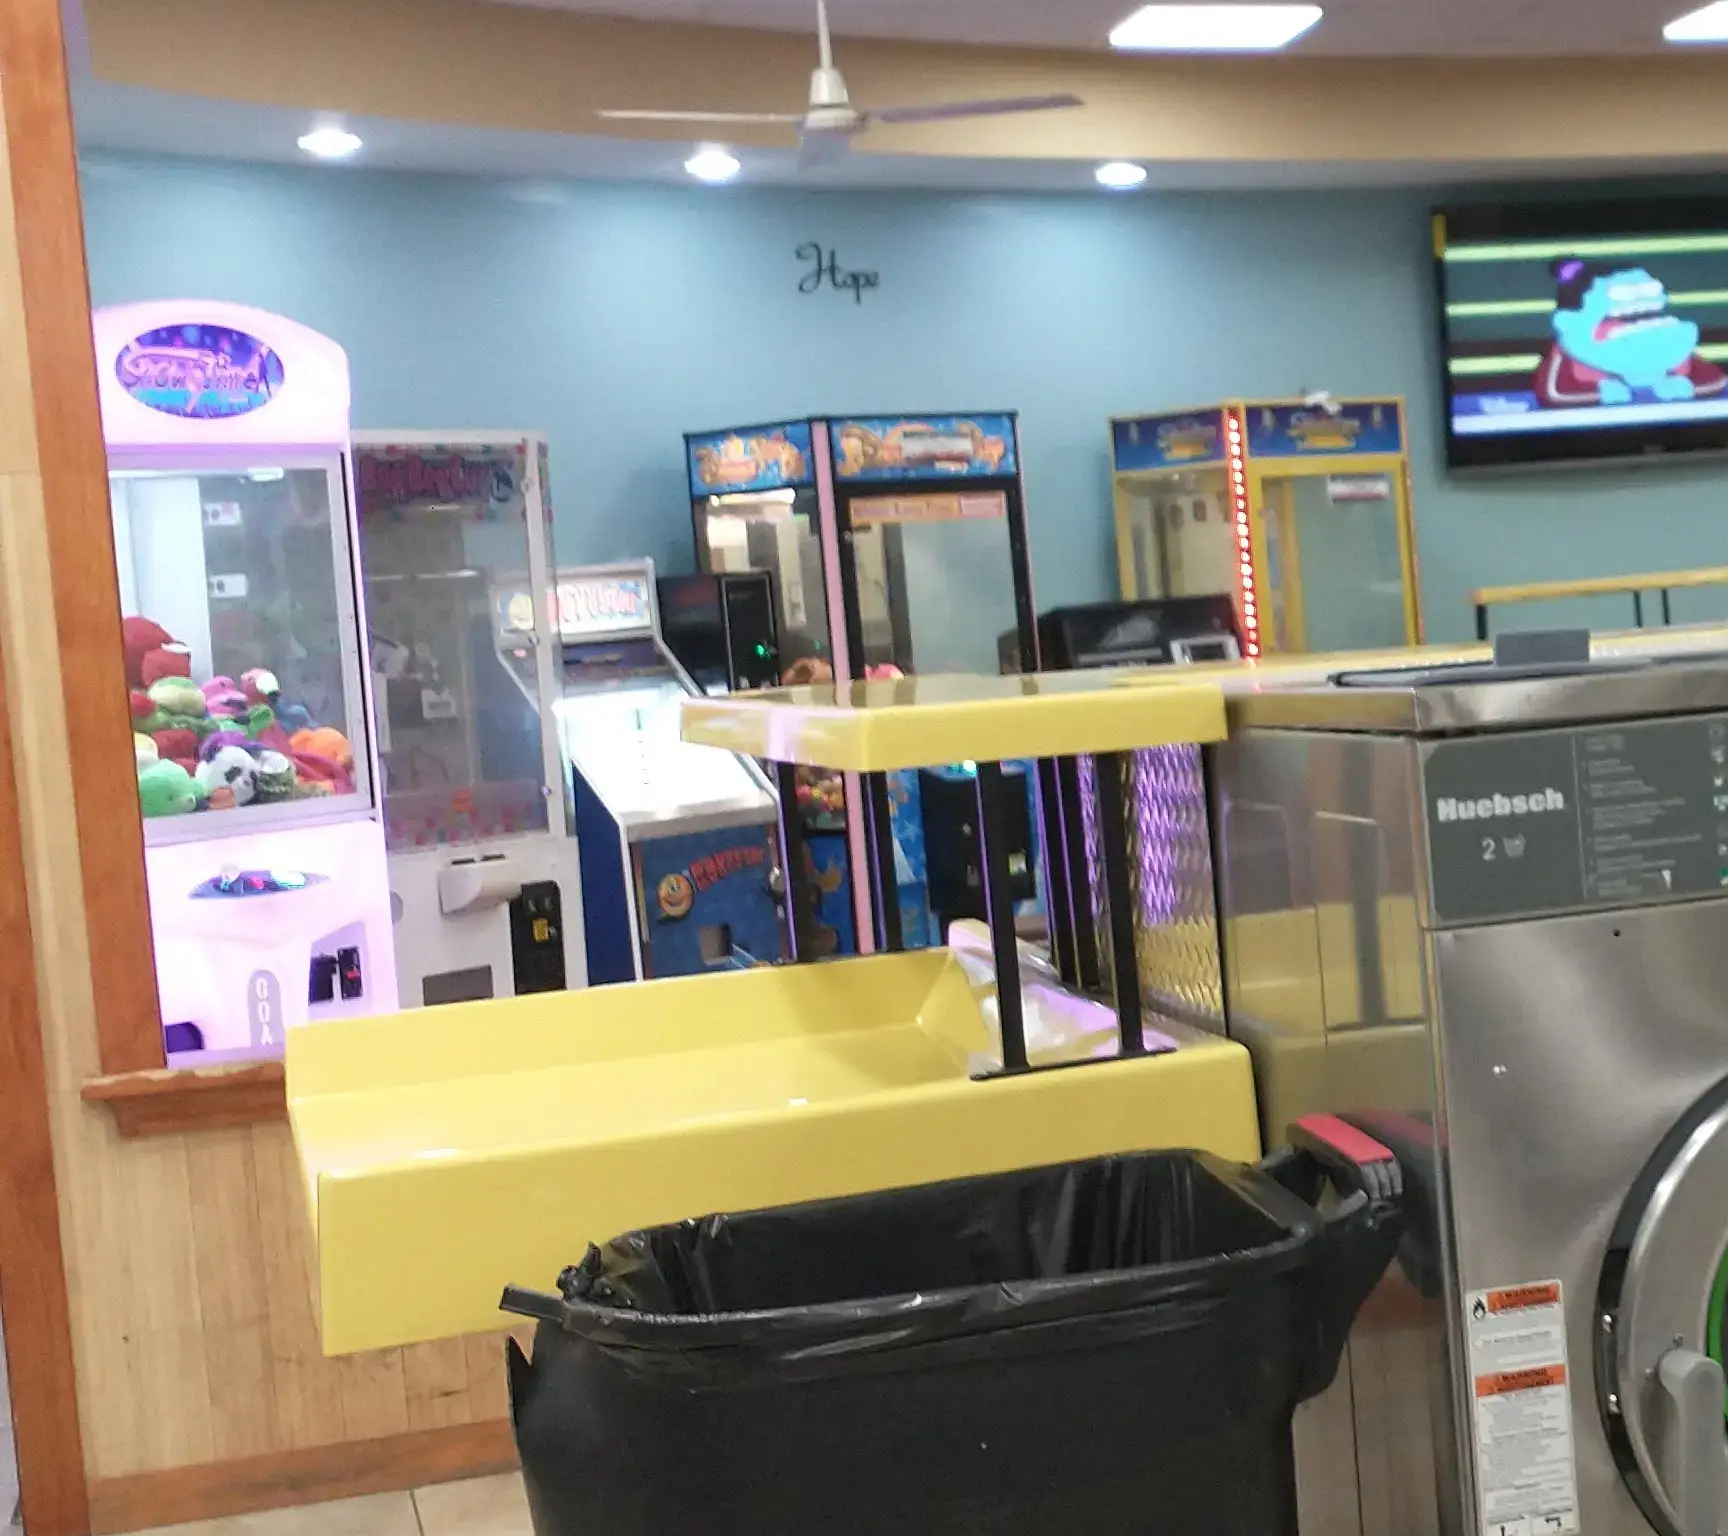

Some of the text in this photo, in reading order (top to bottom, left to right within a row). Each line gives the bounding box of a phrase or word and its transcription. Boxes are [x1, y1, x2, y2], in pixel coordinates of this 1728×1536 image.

[794, 241, 880, 306] Hope
[1436, 786, 1566, 823] Huebsch
[1481, 837, 1497, 861] 2
